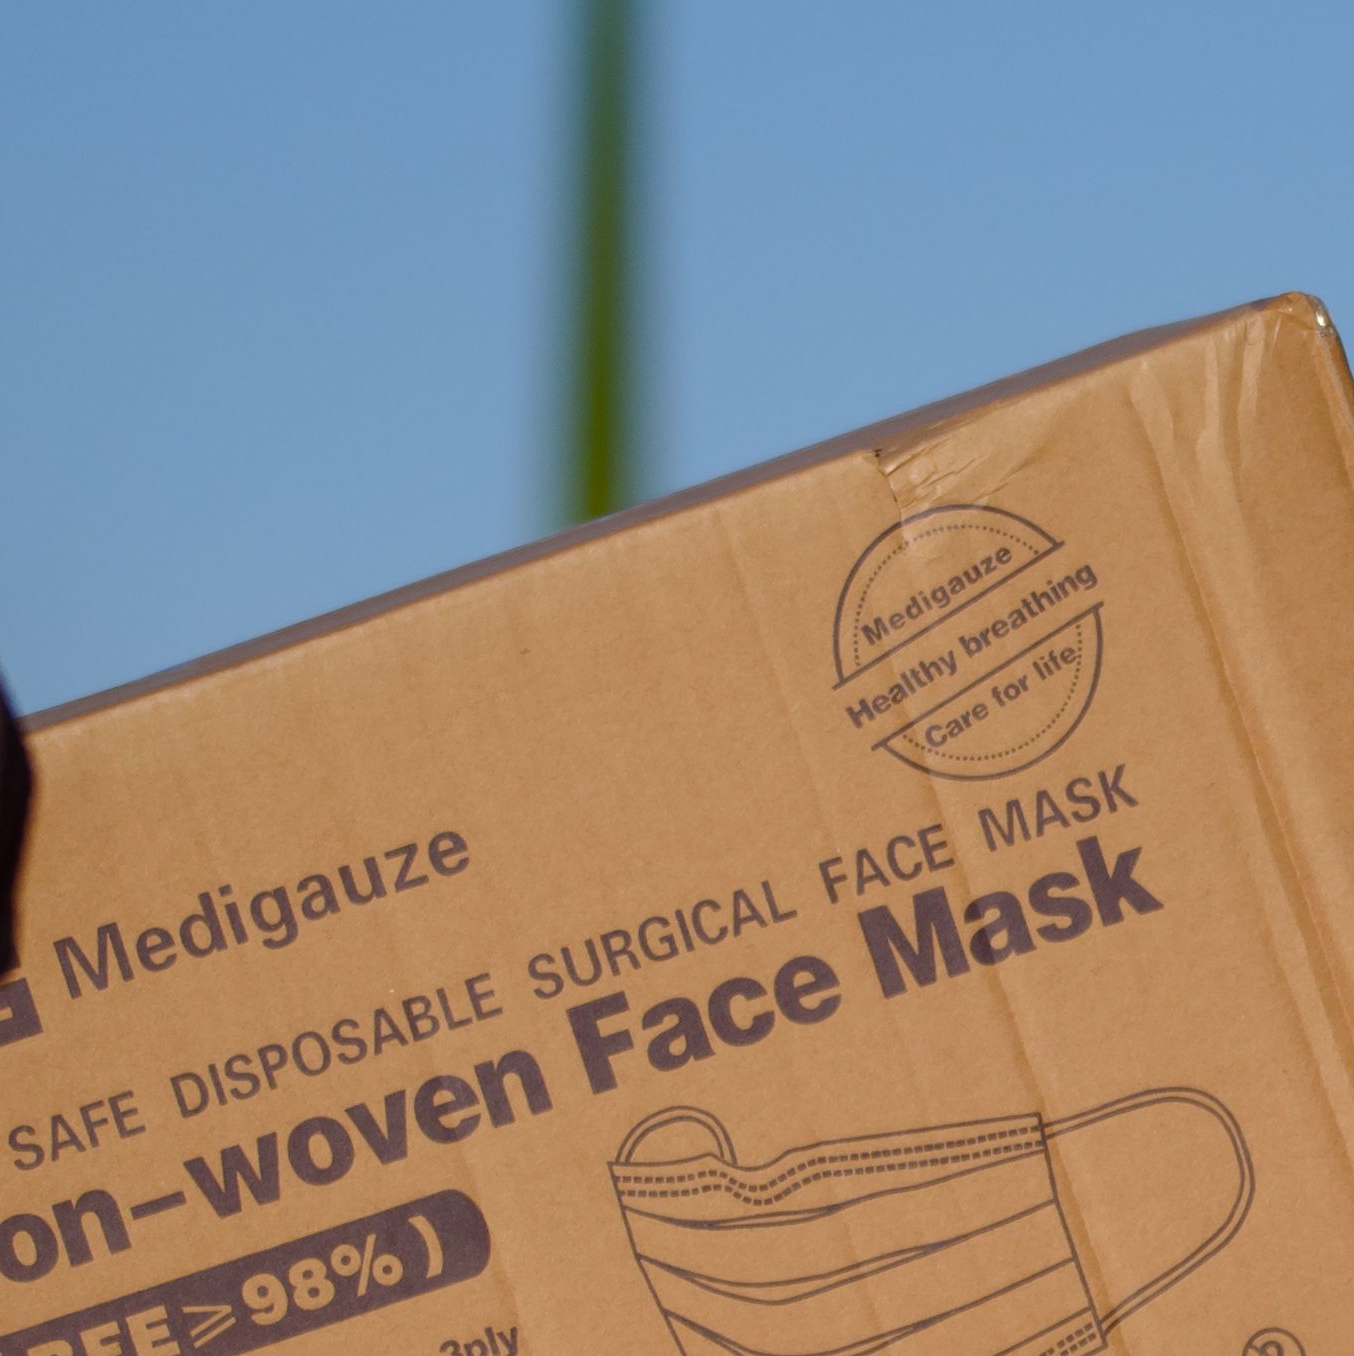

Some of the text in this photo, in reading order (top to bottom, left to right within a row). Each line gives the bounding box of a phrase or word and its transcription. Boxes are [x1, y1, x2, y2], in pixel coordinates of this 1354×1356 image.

[845, 563, 1099, 728] Healthy breathing
[860, 547, 1013, 646] Medigauze
[924, 647, 1076, 748] Care for life
[7, 1090, 146, 1171] SAFE
[170, 973, 502, 1118] DISPOSABLE
[527, 880, 796, 999] SURGICAL
[818, 823, 954, 902] FACE
[976, 765, 1137, 850] MASK
[53, 829, 471, 999] Medigauze
[567, 955, 840, 1094] Face
[859, 837, 1160, 997] Mask
